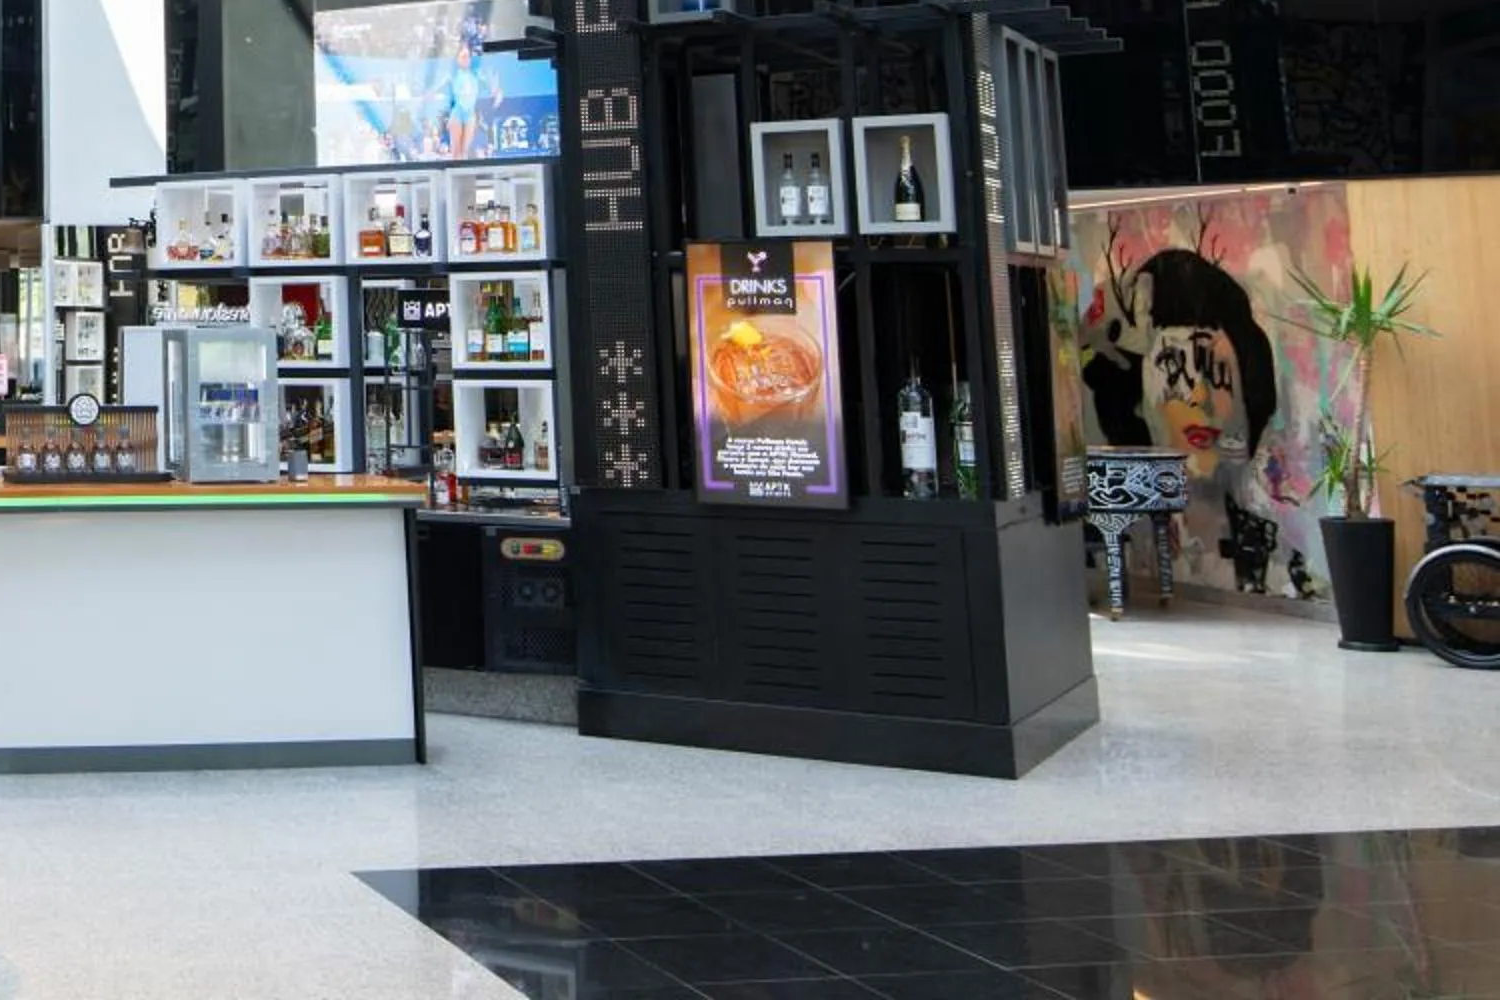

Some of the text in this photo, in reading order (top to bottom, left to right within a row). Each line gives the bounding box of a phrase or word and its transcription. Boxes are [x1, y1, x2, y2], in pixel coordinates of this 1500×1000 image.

[580, 87, 644, 232] HUB
[729, 279, 788, 295] DRINKS
[726, 297, 794, 308] pullman
